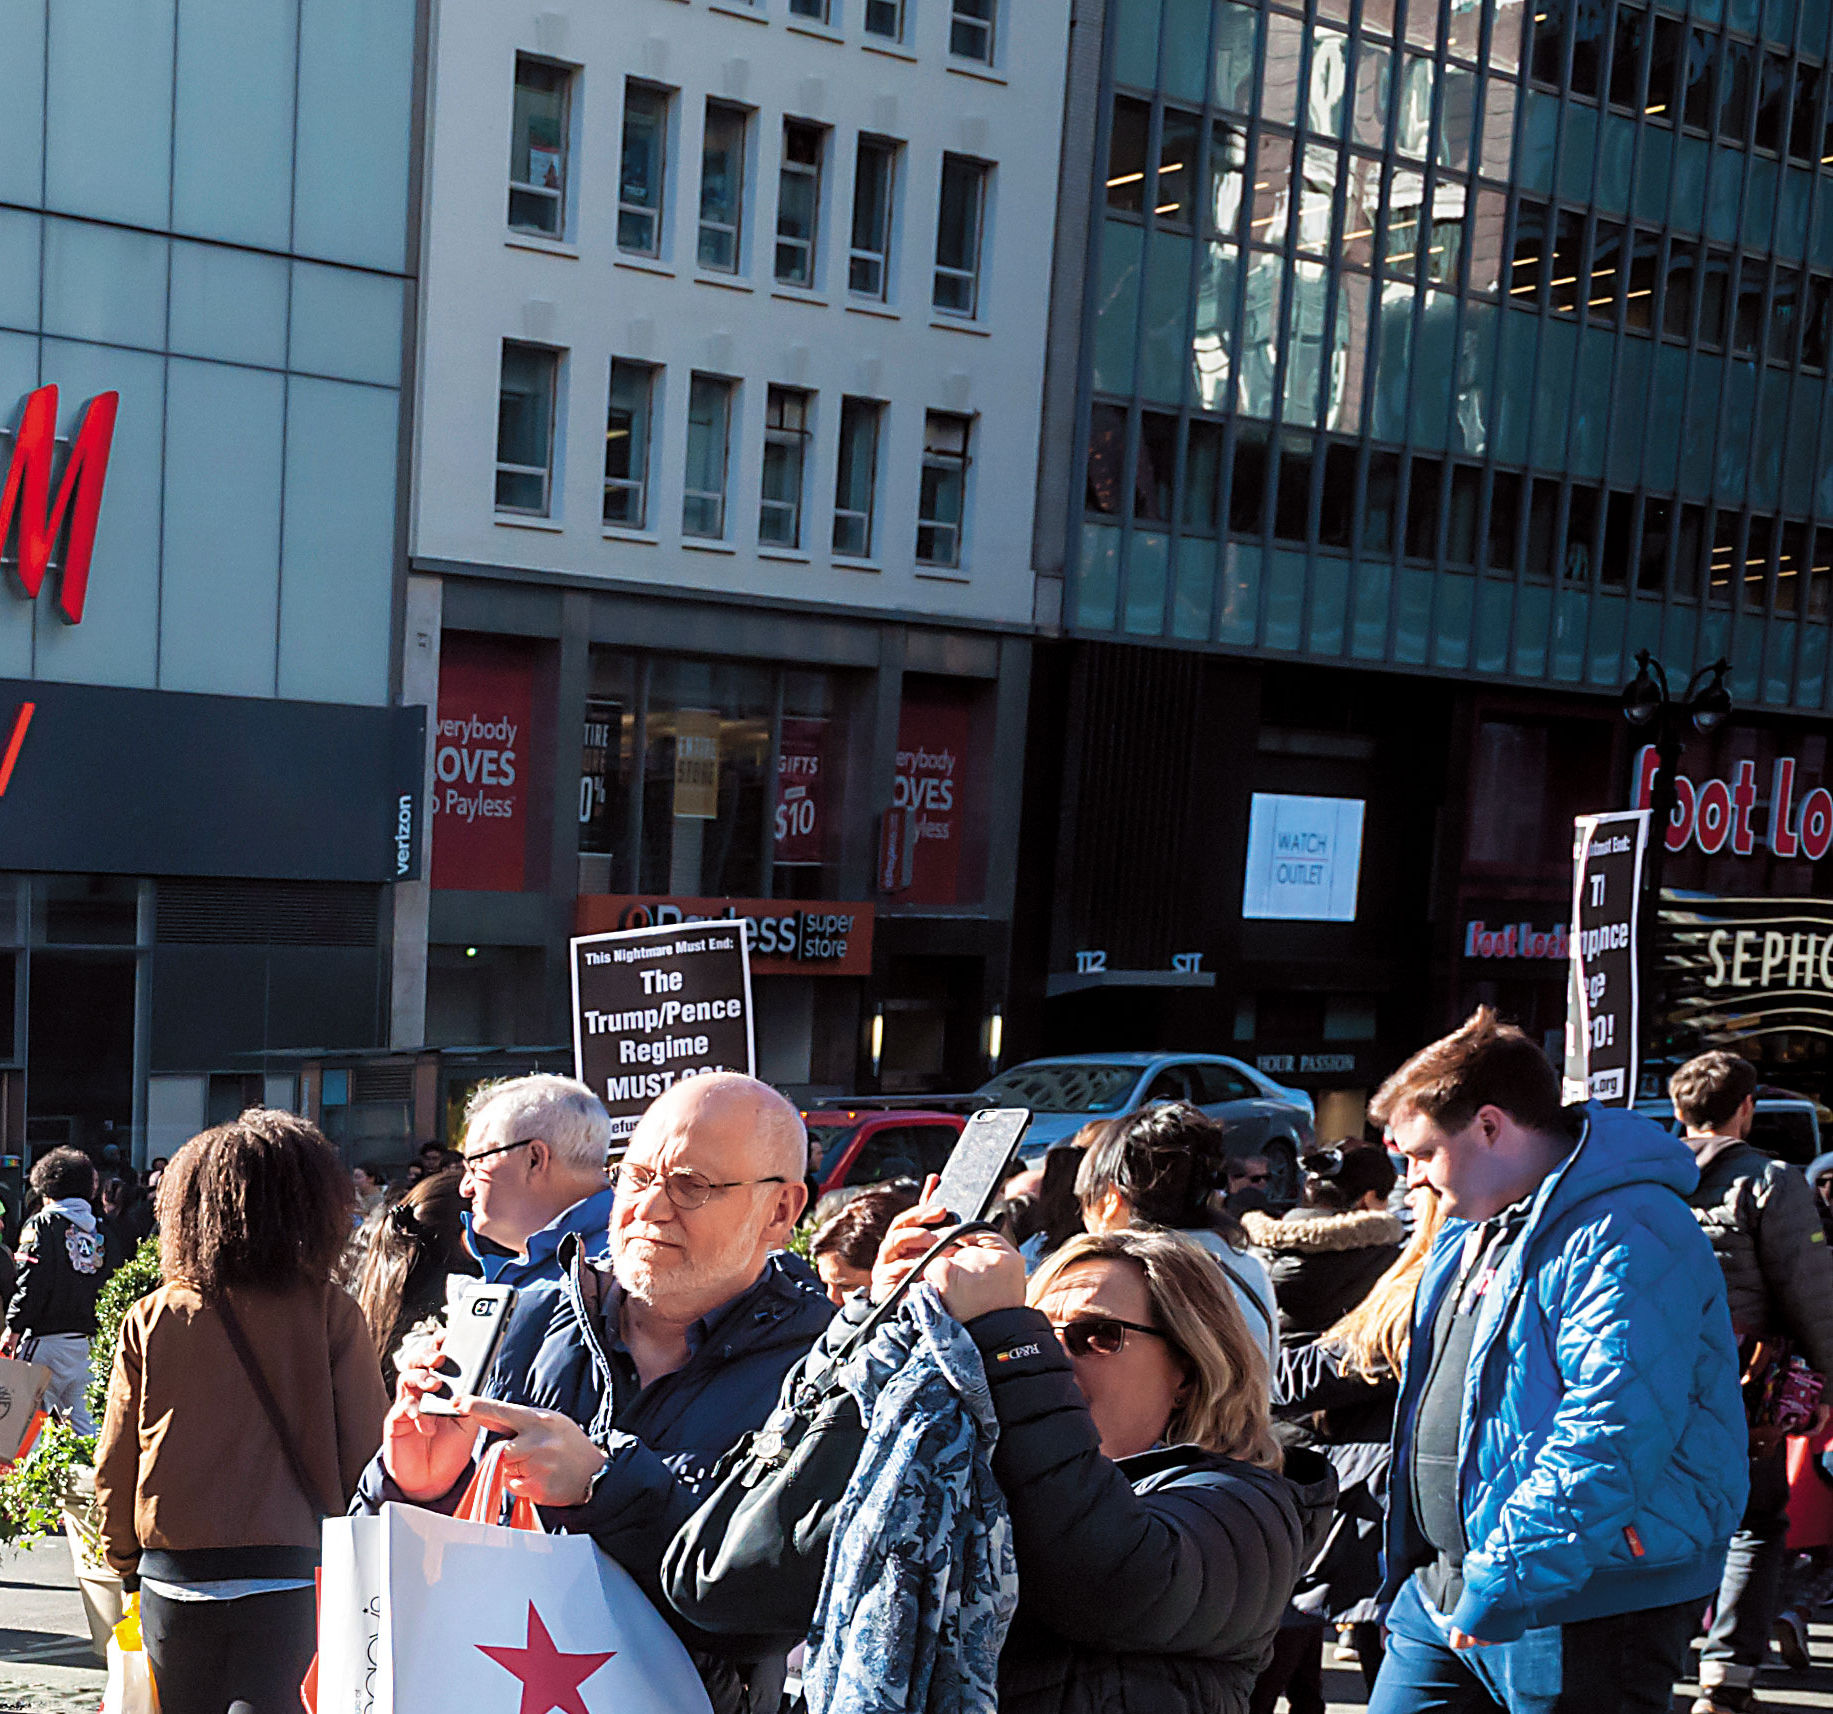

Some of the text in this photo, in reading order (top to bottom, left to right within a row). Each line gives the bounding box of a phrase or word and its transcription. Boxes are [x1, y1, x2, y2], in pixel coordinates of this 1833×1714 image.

[434, 746, 517, 786] OVES
[446, 788, 513, 823] Payless
[775, 799, 815, 841] $10
[395, 794, 413, 876] verizon
[1278, 832, 1327, 855] WATCH
[1277, 863, 1324, 886] OUTLET
[656, 904, 854, 953] Pess super
[585, 937, 734, 966] This Nightmare Must End:
[806, 936, 848, 958] store
[1076, 950, 1107, 974] 112
[640, 969, 683, 995] The
[585, 998, 742, 1035] Trump/Pence
[620, 1035, 709, 1066] Regime
[607, 1071, 674, 1101] MUST
